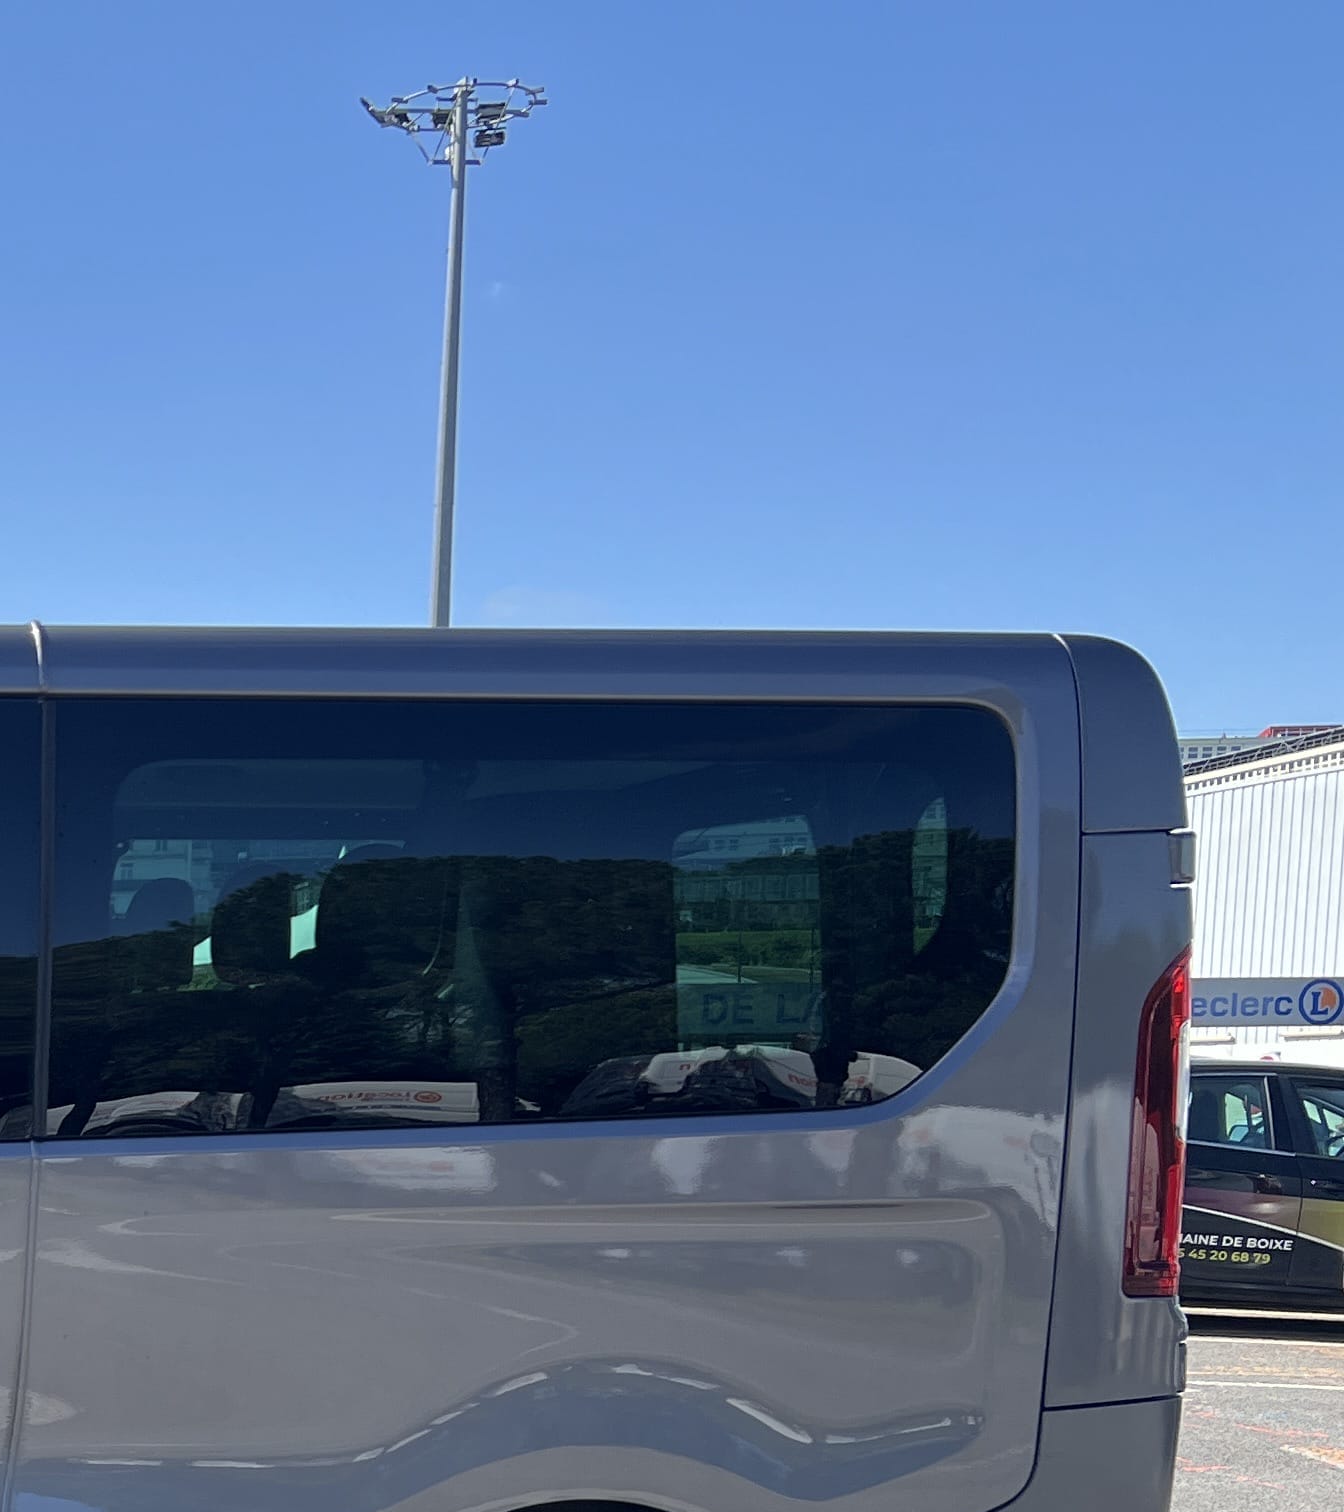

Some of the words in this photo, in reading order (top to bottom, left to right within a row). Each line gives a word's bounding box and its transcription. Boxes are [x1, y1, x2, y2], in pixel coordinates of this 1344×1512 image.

[702, 993, 755, 1025] DE
[1222, 1235, 1244, 1247] DE
[1247, 1237, 1294, 1251] BOIXE
[1188, 1248, 1207, 1260] 45
[1209, 1250, 1228, 1261] 20
[1231, 1251, 1250, 1263] 68
[1253, 1252, 1272, 1265] 79
